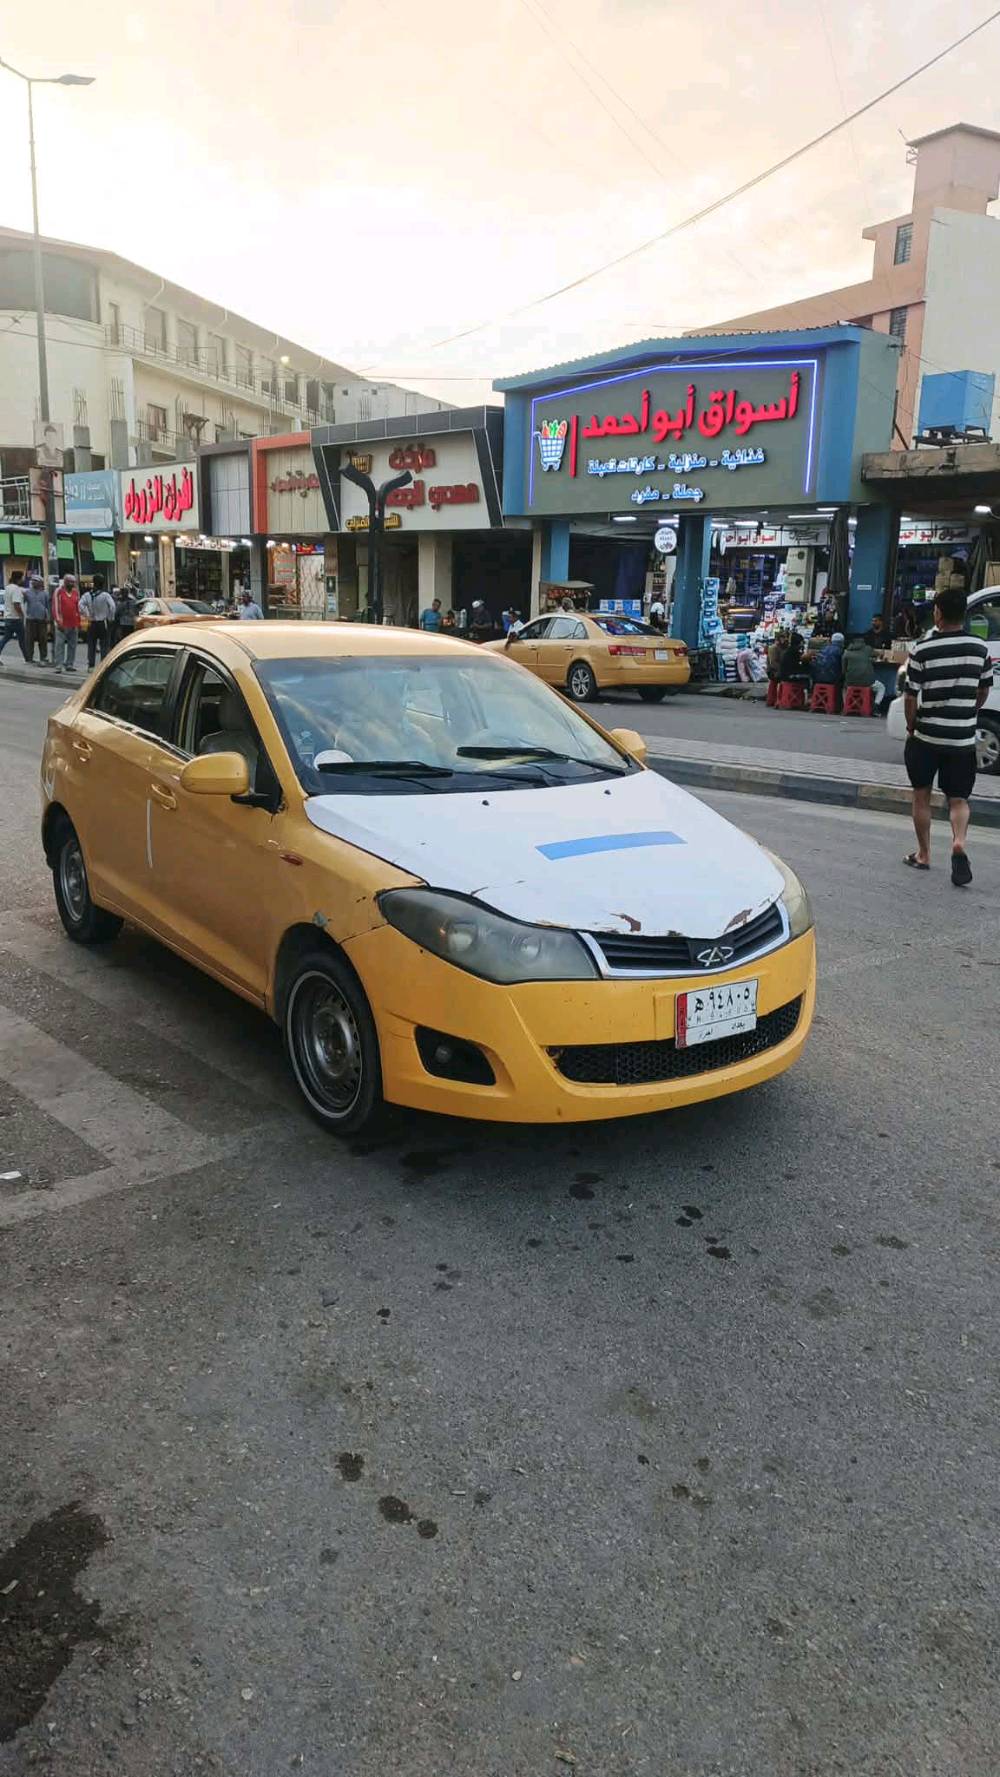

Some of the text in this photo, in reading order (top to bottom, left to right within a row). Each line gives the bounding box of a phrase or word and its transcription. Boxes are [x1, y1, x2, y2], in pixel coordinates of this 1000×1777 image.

[581, 371, 800, 443] أسواق أبو أحمد
[668, 453, 707, 473] منزلية
[721, 447, 765, 470] غذائية
[631, 486, 660, 505] مفرد
[672, 484, 704, 503] جملة
